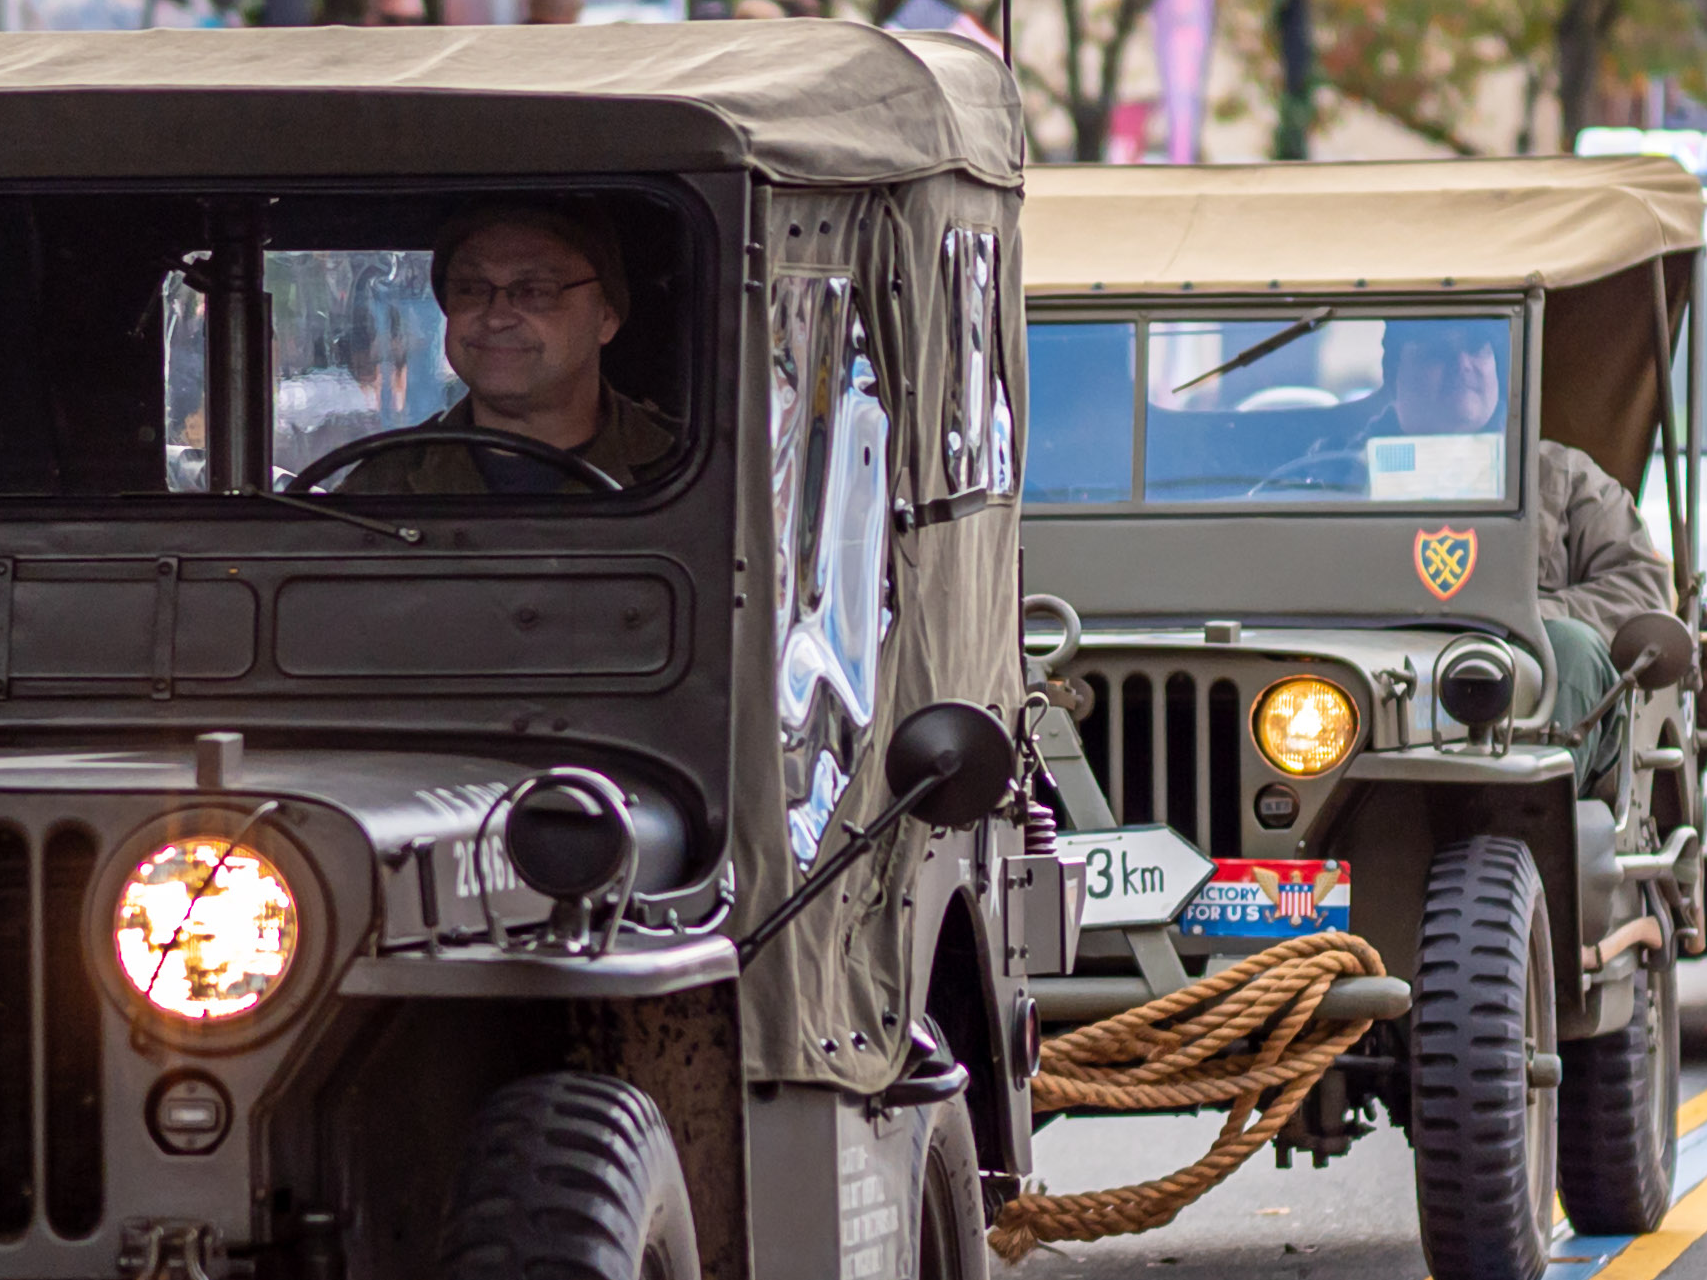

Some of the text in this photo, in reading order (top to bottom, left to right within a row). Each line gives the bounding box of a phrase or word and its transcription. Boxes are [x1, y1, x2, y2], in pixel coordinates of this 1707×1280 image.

[1085, 847, 1165, 900] 3 km
[1199, 886, 1261, 902] ICTORY
[1187, 905, 1222, 921] FOR
